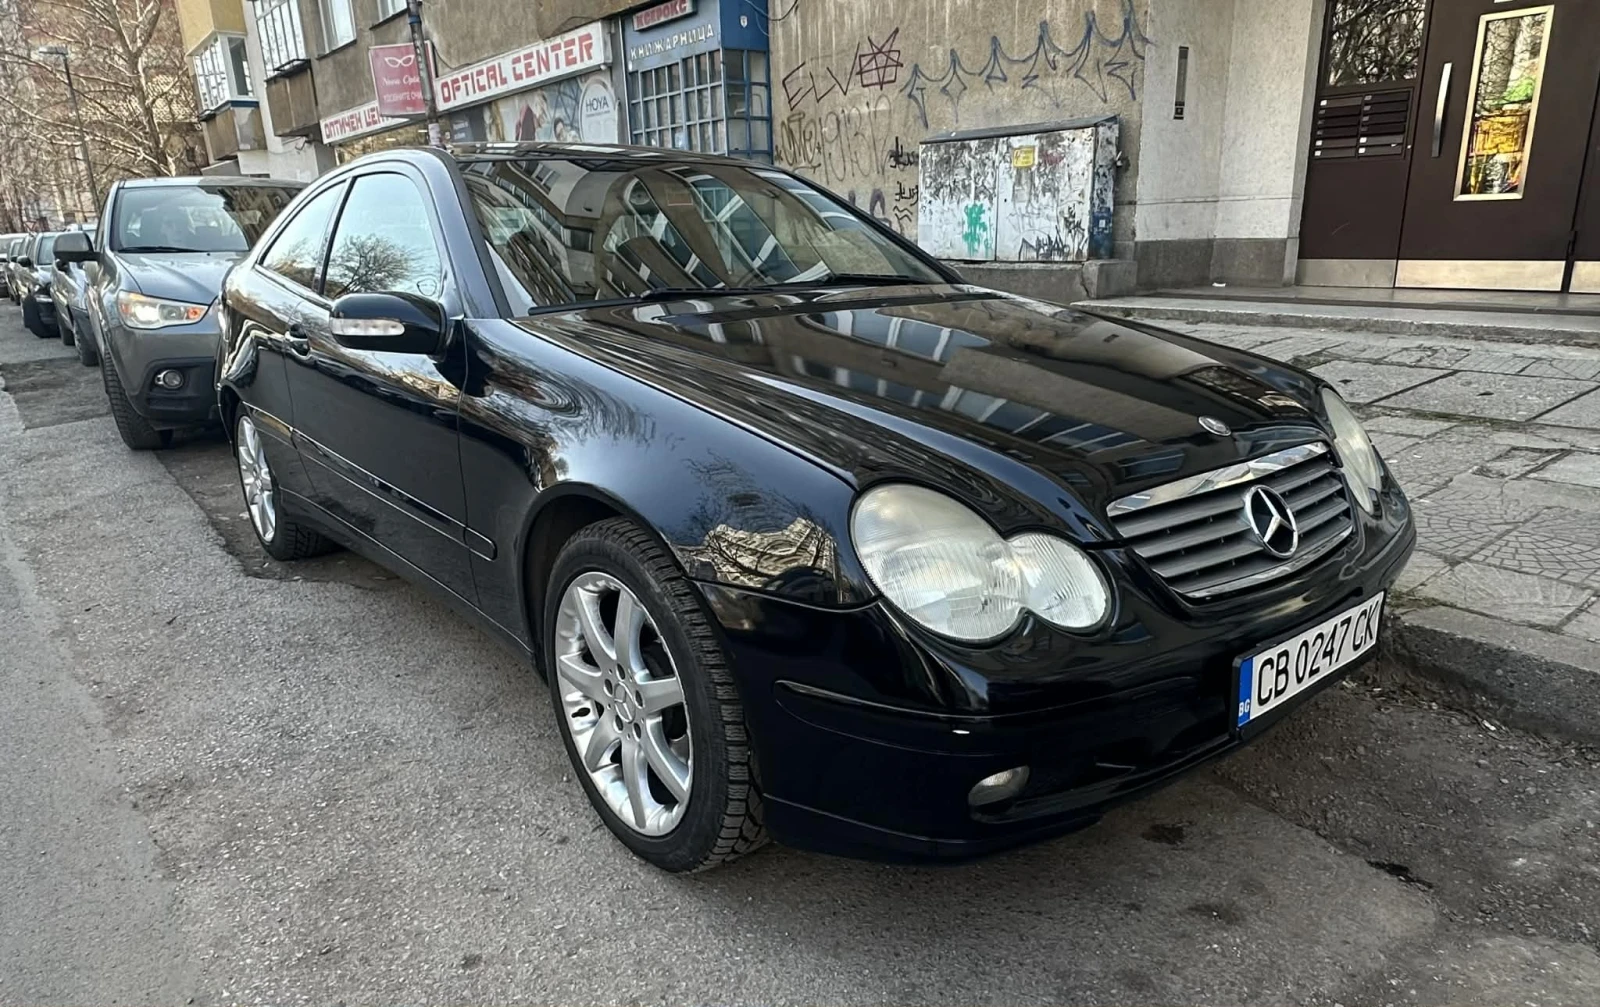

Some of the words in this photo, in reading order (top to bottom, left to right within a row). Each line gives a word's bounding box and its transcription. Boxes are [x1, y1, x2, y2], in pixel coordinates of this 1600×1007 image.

[637, 0, 688, 28] КСЕРОКС
[630, 24, 714, 60] КНИЖАРНИЦА
[440, 61, 508, 103] OPTICAL
[511, 32, 594, 82] CENTER
[585, 94, 610, 113] HOYA
[323, 111, 363, 140] ОПТИЧЕН
[1257, 649, 1290, 707] CB
[1295, 615, 1353, 685] 0247
[1352, 600, 1380, 652] CK
[1238, 698, 1251, 718] BG
